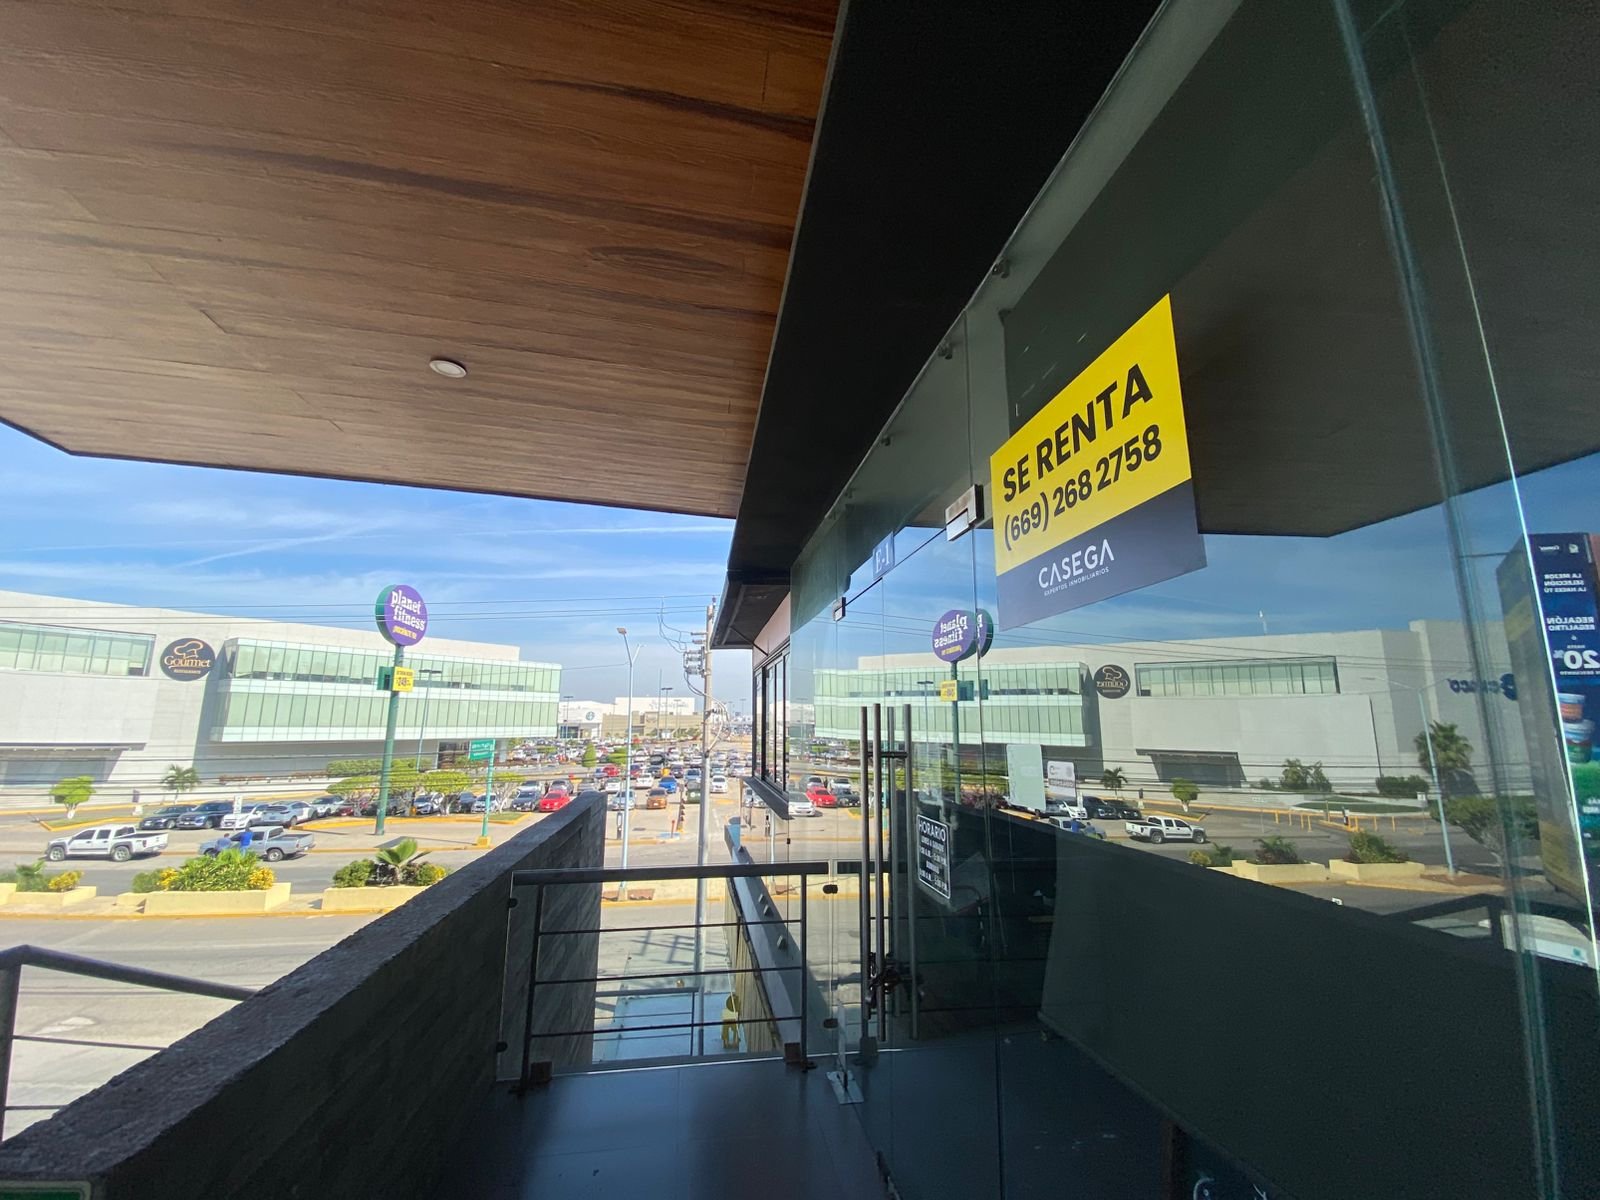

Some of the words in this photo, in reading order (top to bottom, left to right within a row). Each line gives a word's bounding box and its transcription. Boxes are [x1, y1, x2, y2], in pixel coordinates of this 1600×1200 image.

[1003, 454, 1031, 502] SE
[1036, 363, 1153, 480] RENTA
[1005, 492, 1049, 550] (669)
[1053, 469, 1092, 517] 268
[1096, 424, 1162, 491] 2758
[1038, 539, 1114, 588] CASEGA
[1044, 583, 1068, 596] EXPERTOS
[1068, 566, 1110, 587] INMOBILIARIOS
[390, 589, 421, 615] planet
[393, 604, 427, 631] fitness
[164, 655, 210, 669] Gourmet
[919, 821, 946, 842] HORARIO
